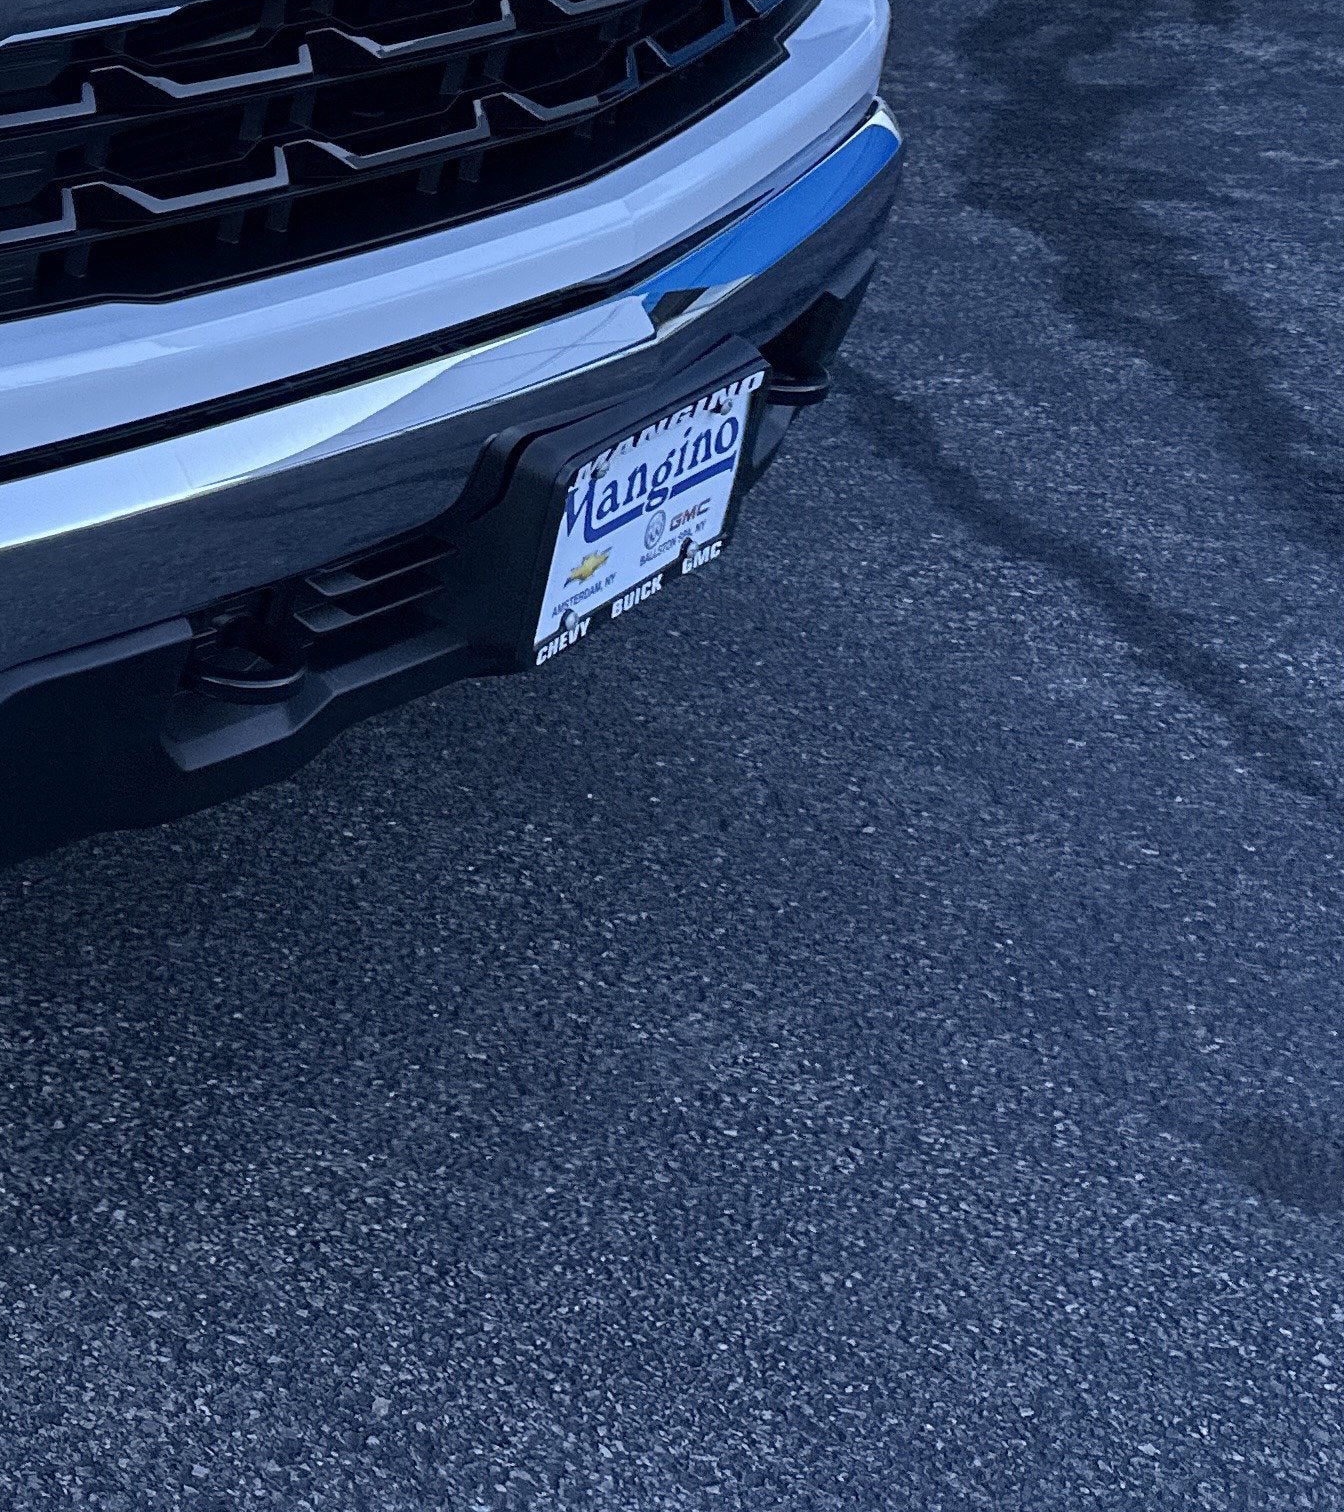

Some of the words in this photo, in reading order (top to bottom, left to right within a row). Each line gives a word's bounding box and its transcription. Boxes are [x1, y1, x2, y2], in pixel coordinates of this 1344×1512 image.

[566, 416, 740, 543] Mangino
[669, 498, 712, 531] GMC
[536, 617, 591, 666] CHEVY
[611, 573, 663, 619] BUICK
[682, 541, 723, 575] GMC
